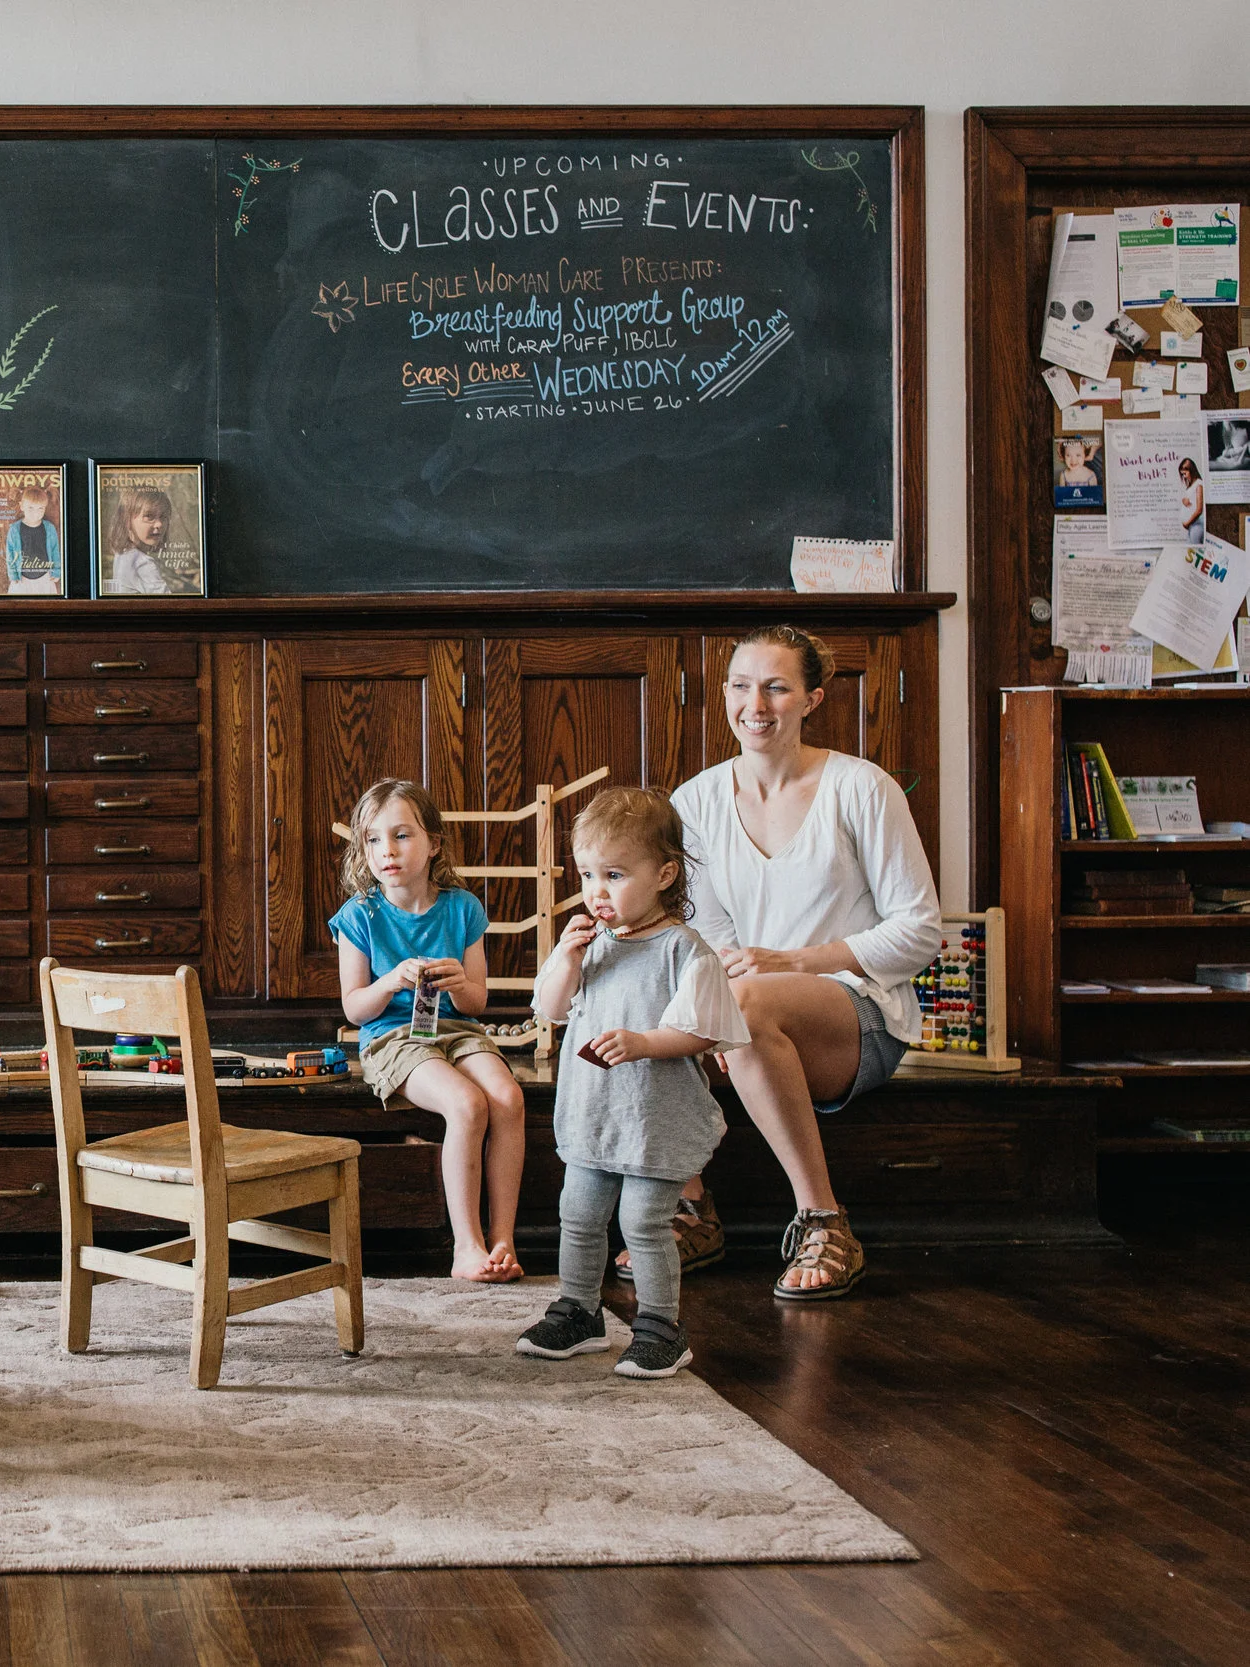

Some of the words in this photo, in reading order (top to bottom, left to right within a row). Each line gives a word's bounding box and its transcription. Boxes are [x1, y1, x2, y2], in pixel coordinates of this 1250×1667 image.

[577, 196, 621, 218] AND
[473, 261, 550, 296] WOMAN
[558, 256, 604, 295] CARE
[620, 255, 725, 285] PRESENTS:
[408, 294, 564, 348] Breastfeeding
[572, 295, 673, 342] Support
[464, 338, 501, 354] WITH
[507, 335, 551, 355] CARA
[624, 330, 678, 352] IBCLC
[533, 352, 687, 402] WEDNESDAY
[582, 396, 644, 415] JUNE
[1185, 547, 1228, 583] STEM
